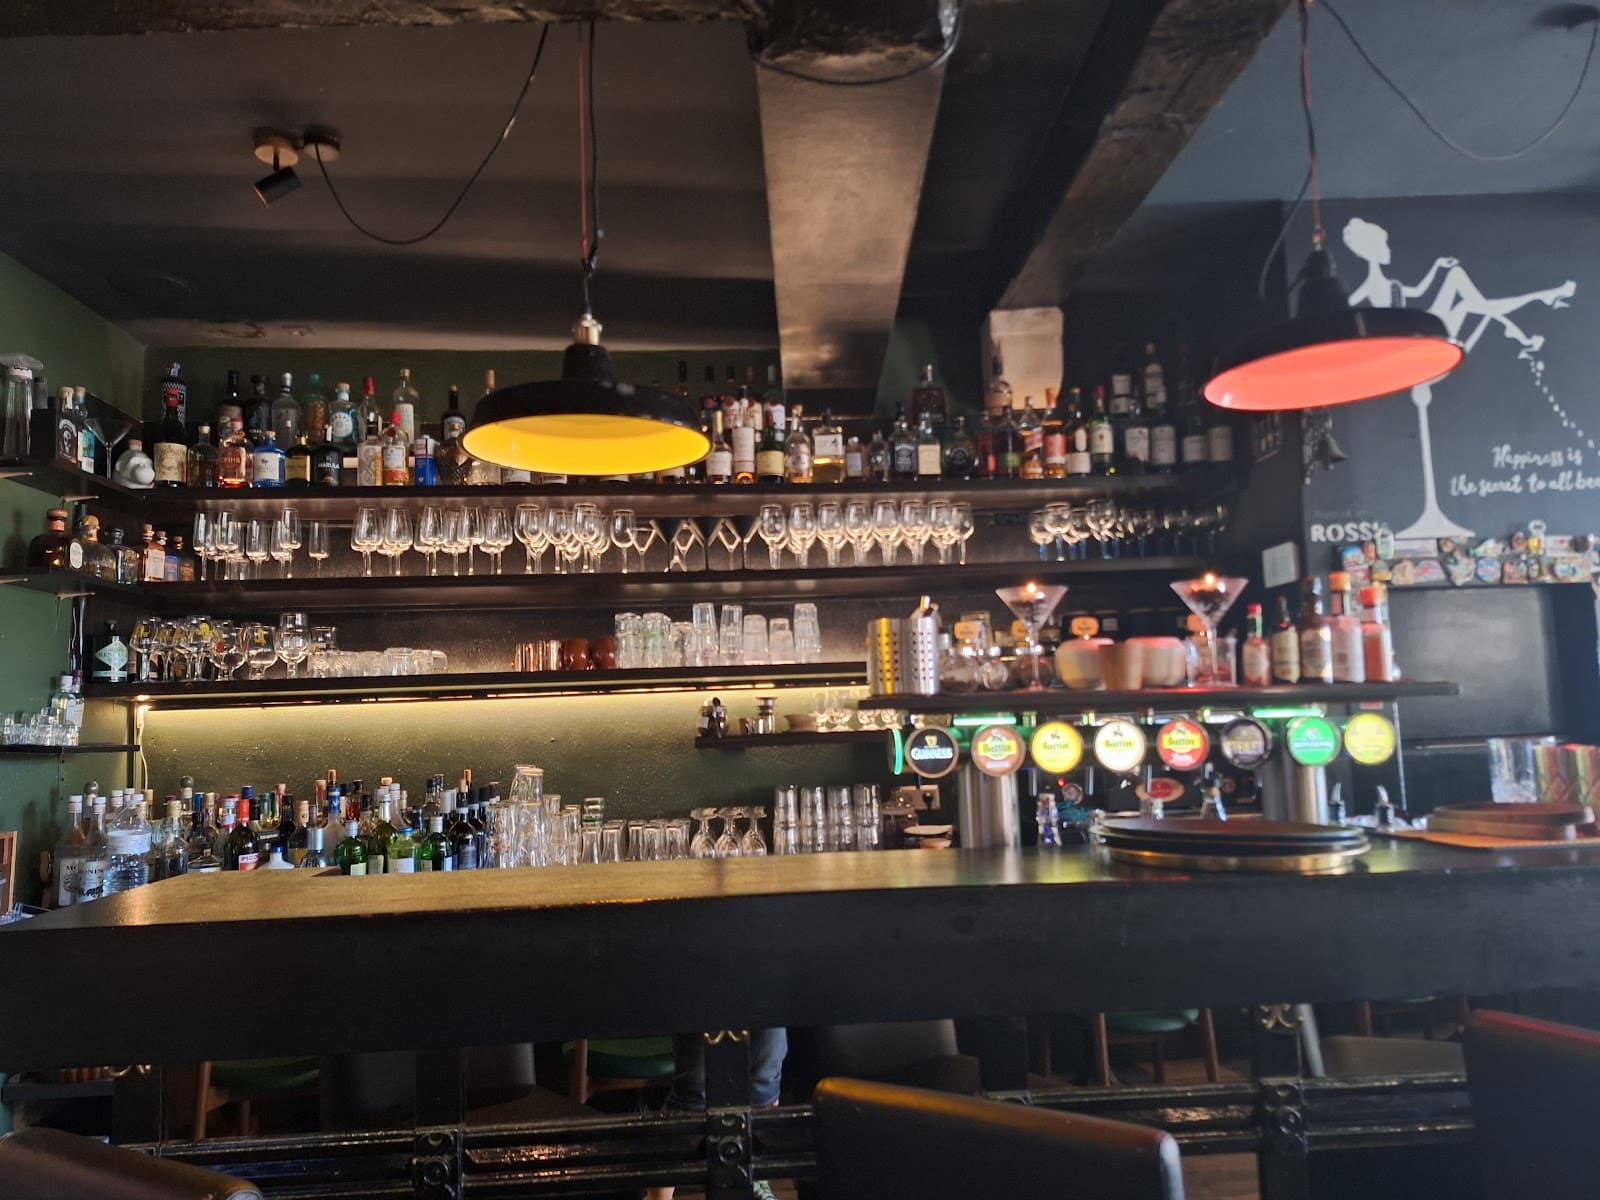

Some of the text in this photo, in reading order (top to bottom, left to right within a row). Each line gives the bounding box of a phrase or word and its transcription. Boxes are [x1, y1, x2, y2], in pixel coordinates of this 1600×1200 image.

[1491, 443, 1583, 470] Happiness is
[1450, 473, 1477, 497] the
[1526, 472, 1547, 493] to
[1548, 470, 1573, 491] all
[1310, 520, 1388, 543] ROSS'
